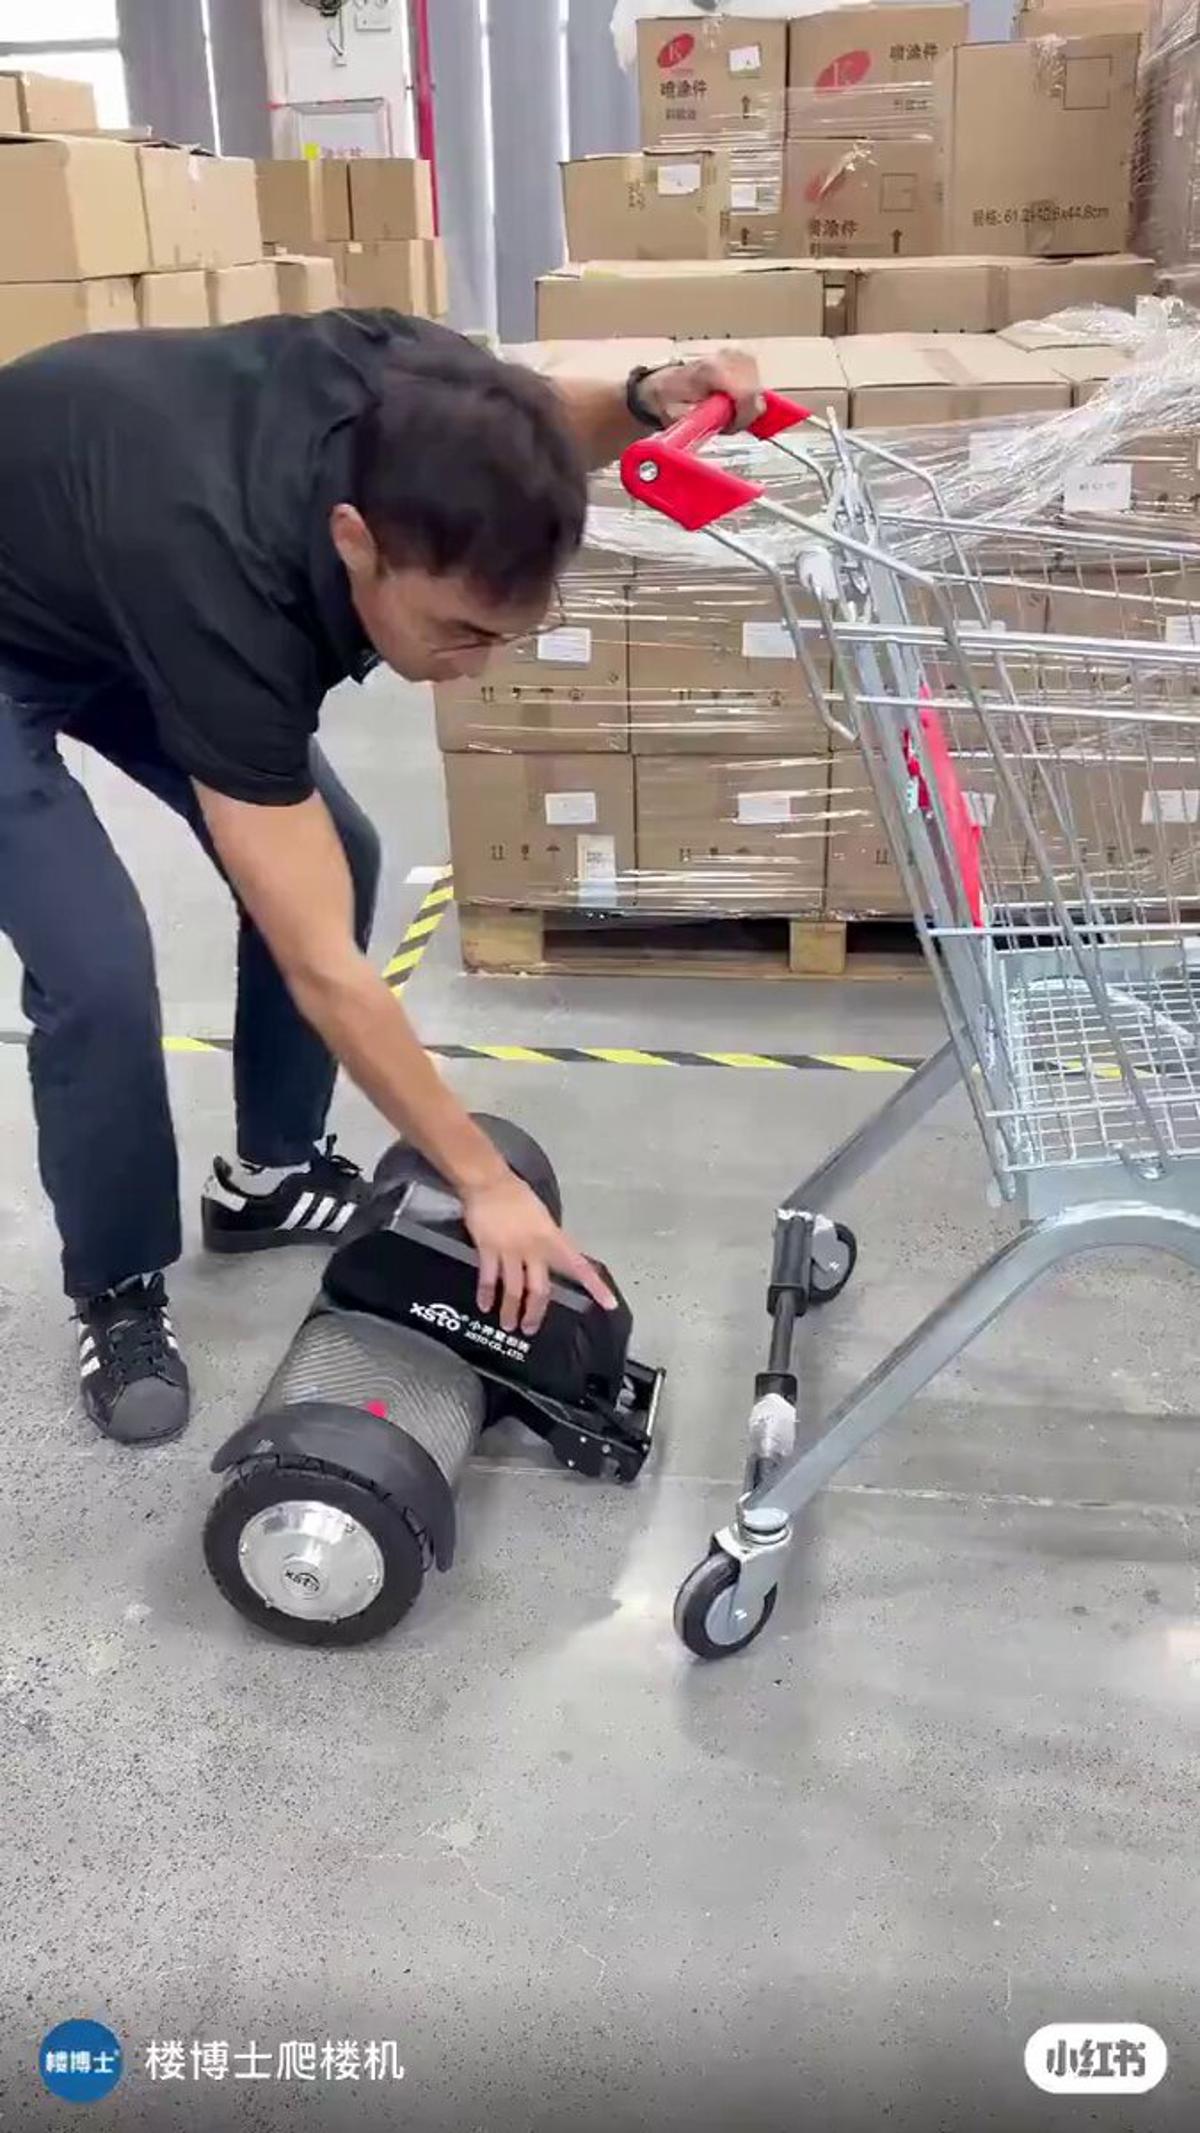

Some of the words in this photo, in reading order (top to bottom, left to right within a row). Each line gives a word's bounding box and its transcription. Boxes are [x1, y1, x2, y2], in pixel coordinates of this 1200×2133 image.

[889, 42, 938, 61] 喷涂件
[660, 79, 707, 99] 喷涂件
